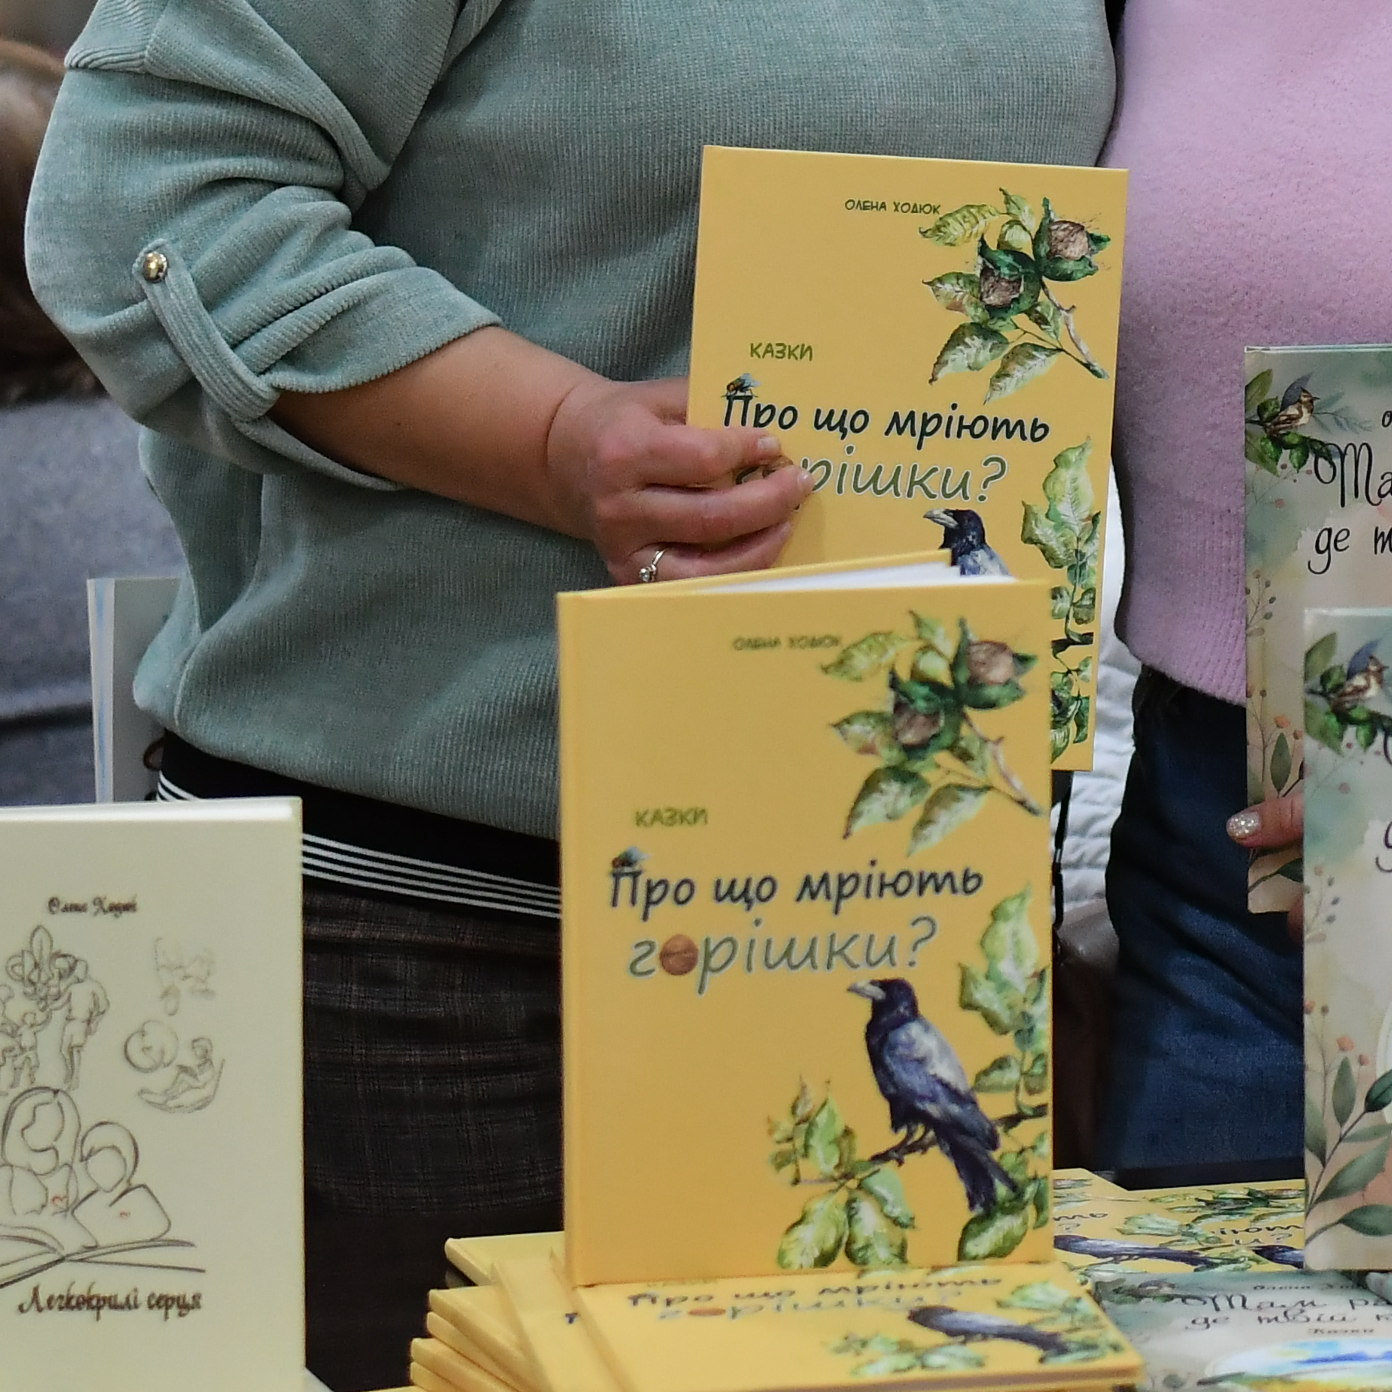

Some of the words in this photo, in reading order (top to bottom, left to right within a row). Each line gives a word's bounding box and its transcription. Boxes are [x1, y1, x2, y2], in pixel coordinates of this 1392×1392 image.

[844, 199, 887, 213] ОЛЕНА
[893, 200, 941, 215] ХОДЮК
[749, 341, 813, 362] КАЗКИ
[722, 394, 798, 430] Про
[814, 408, 870, 441] що
[885, 402, 1050, 450] мріють
[799, 444, 1009, 503] рішки?
[1307, 525, 1351, 575] де
[635, 806, 708, 828] КАЗКИ
[610, 866, 695, 922] Про
[714, 873, 777, 911] що
[796, 859, 983, 916] мріють
